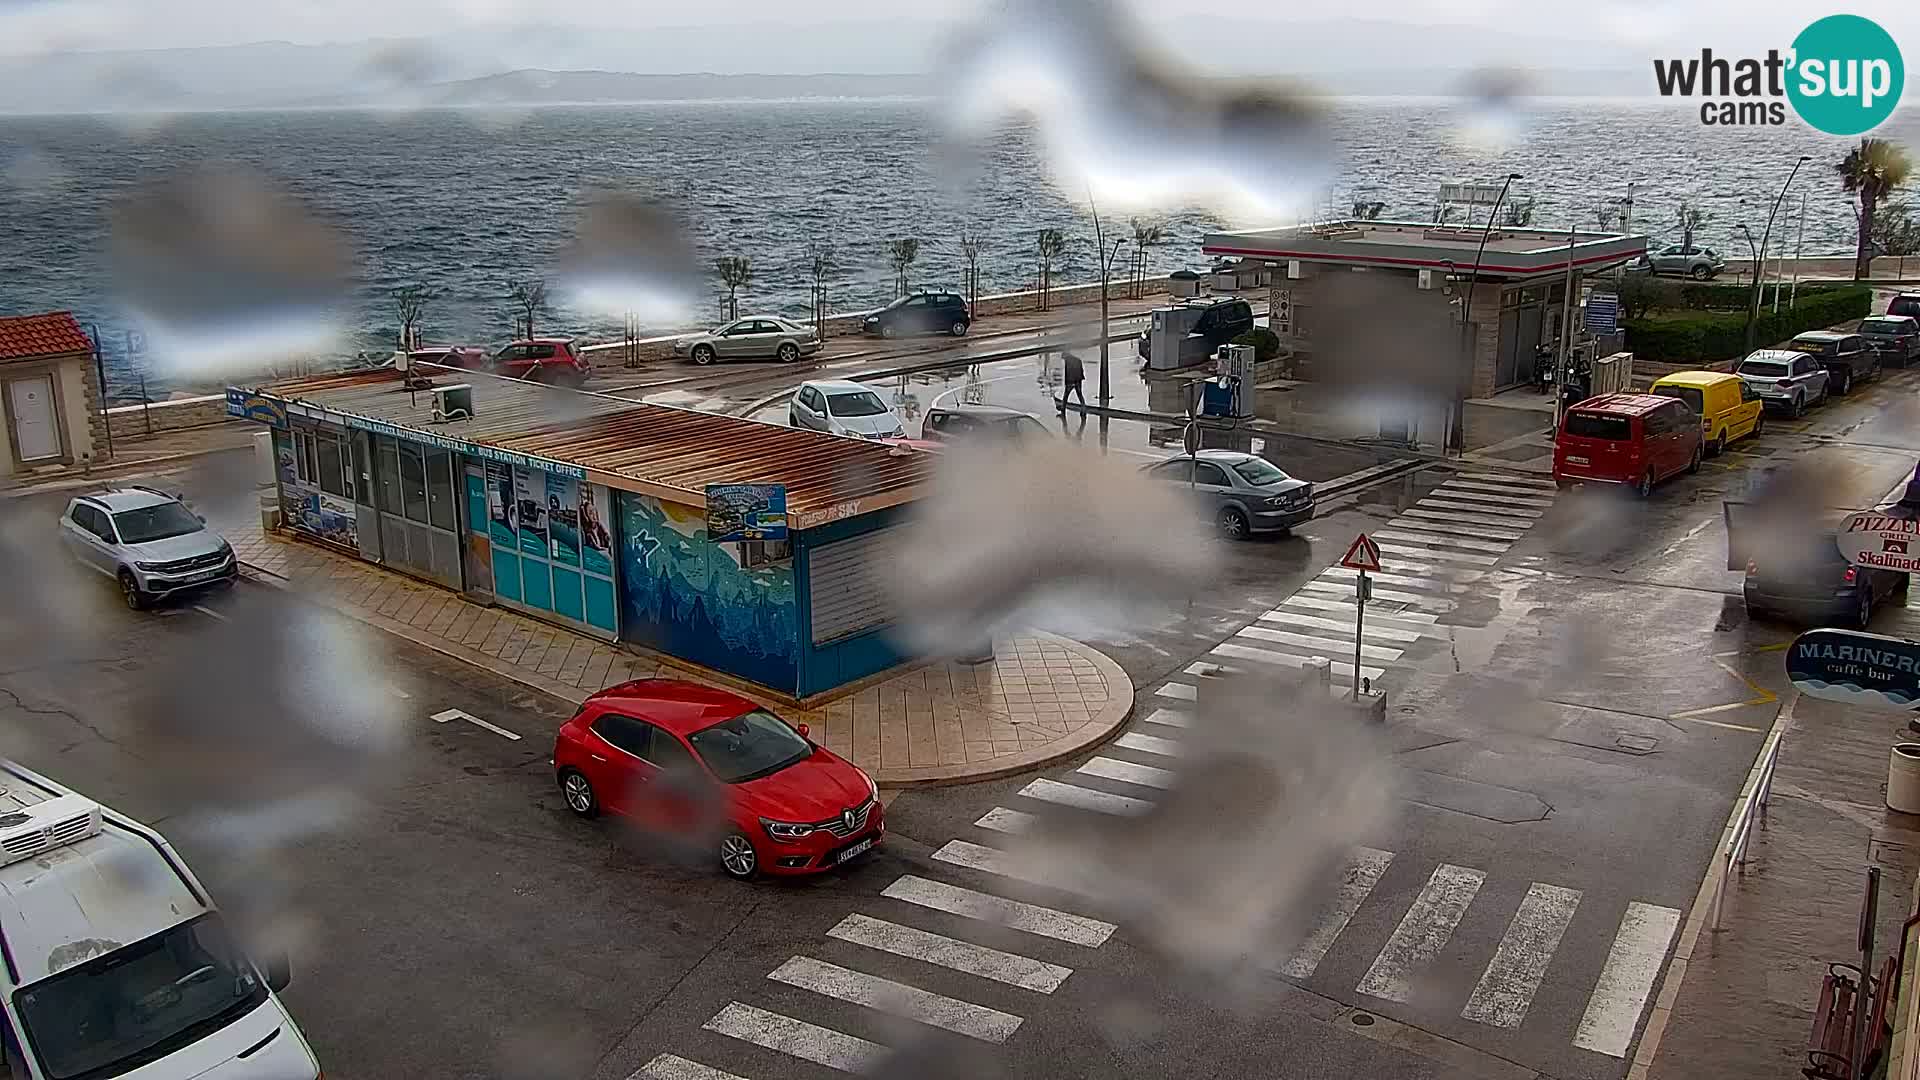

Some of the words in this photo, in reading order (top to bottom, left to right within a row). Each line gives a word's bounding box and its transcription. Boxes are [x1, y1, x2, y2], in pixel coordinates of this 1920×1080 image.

[437, 438, 468, 453] POSTAJA
[478, 447, 493, 458] BUS
[494, 451, 526, 466] STATION
[528, 458, 554, 473] TICKET
[555, 465, 582, 478] OFFICE
[1827, 663, 1863, 676] caffe
[1868, 667, 1895, 681] bar
